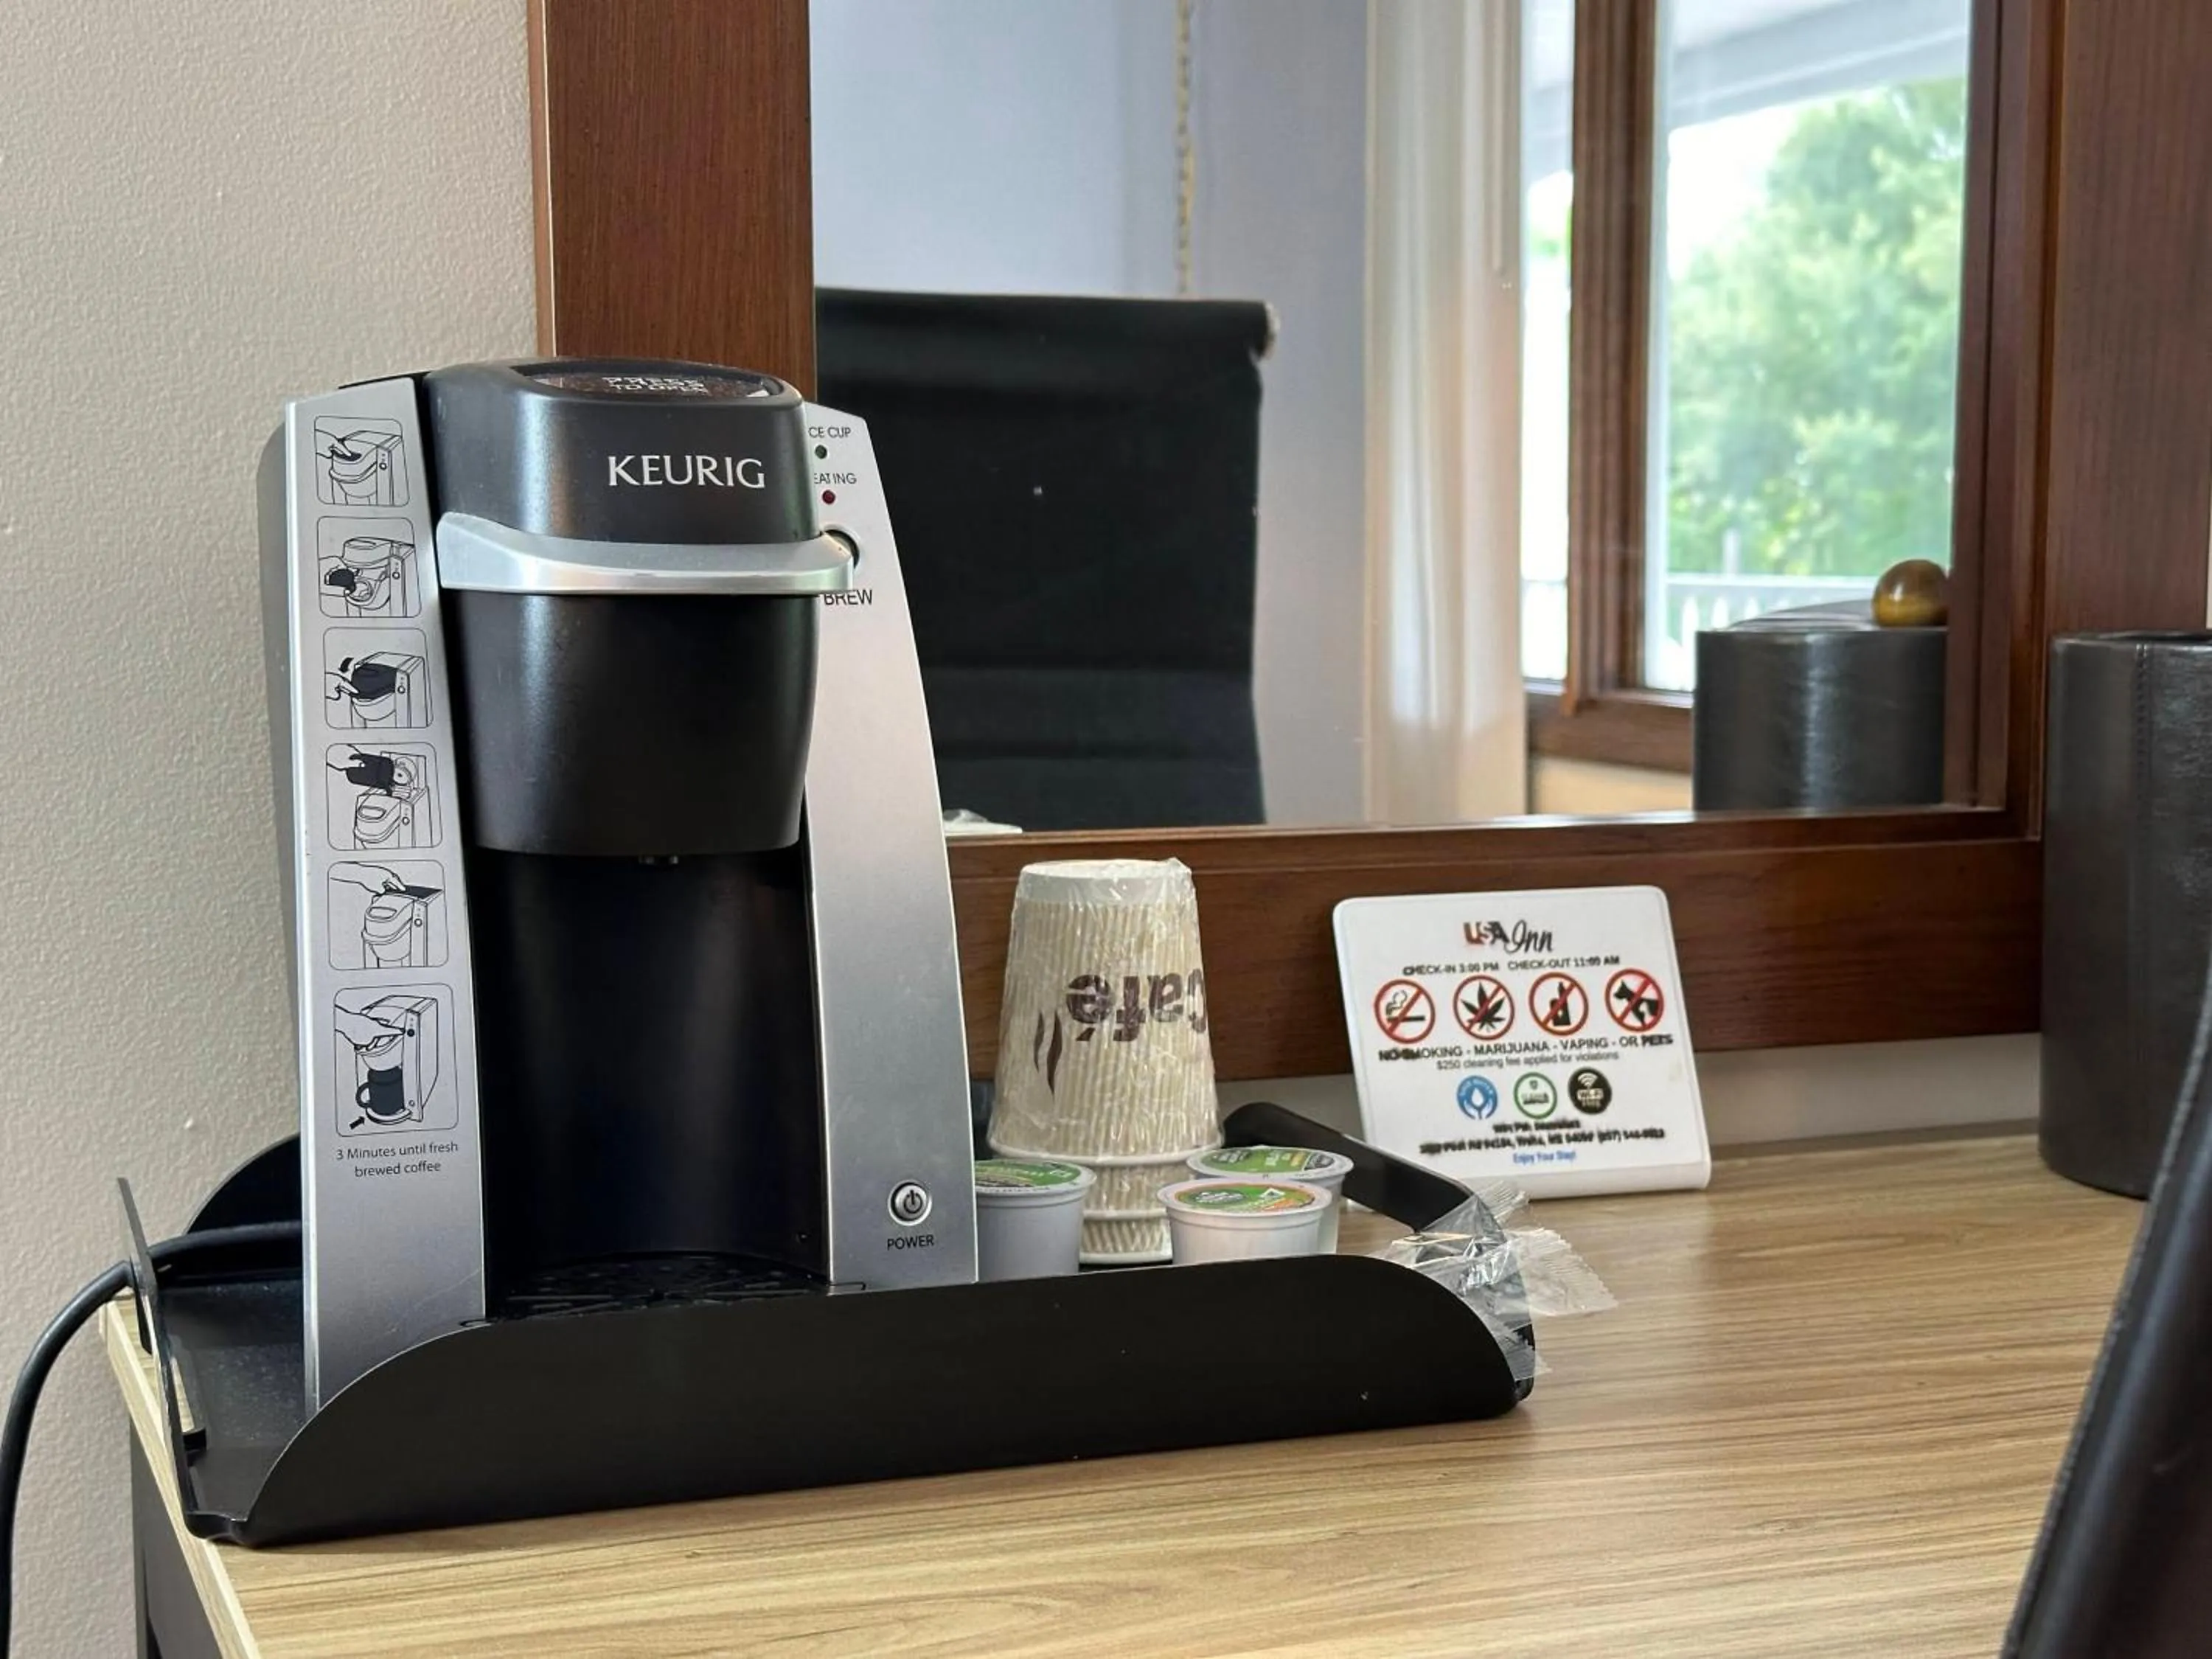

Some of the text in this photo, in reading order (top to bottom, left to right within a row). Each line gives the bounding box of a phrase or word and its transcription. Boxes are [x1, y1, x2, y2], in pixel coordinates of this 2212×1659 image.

[827, 426, 852, 438] CUP
[607, 454, 765, 489] KEURIG
[823, 589, 872, 605] BREW
[1463, 919, 1554, 954] USA Inn
[1402, 963, 1456, 975] CHECK-IN
[1459, 962, 1481, 973] 3:00
[1483, 961, 1500, 972] PM
[1507, 959, 1570, 971] CHECK-OUT
[1604, 955, 1621, 966] AM
[1401, 1046, 1463, 1060] MOKING
[1474, 1041, 1550, 1056] MARIJUANA
[1559, 1037, 1608, 1050] VAPING
[1619, 1035, 1638, 1048] OR
[336, 1141, 459, 1161] 3 Minutes until fresh
[354, 1160, 442, 1178] brewed coffee
[887, 1234, 935, 1251] POWER
